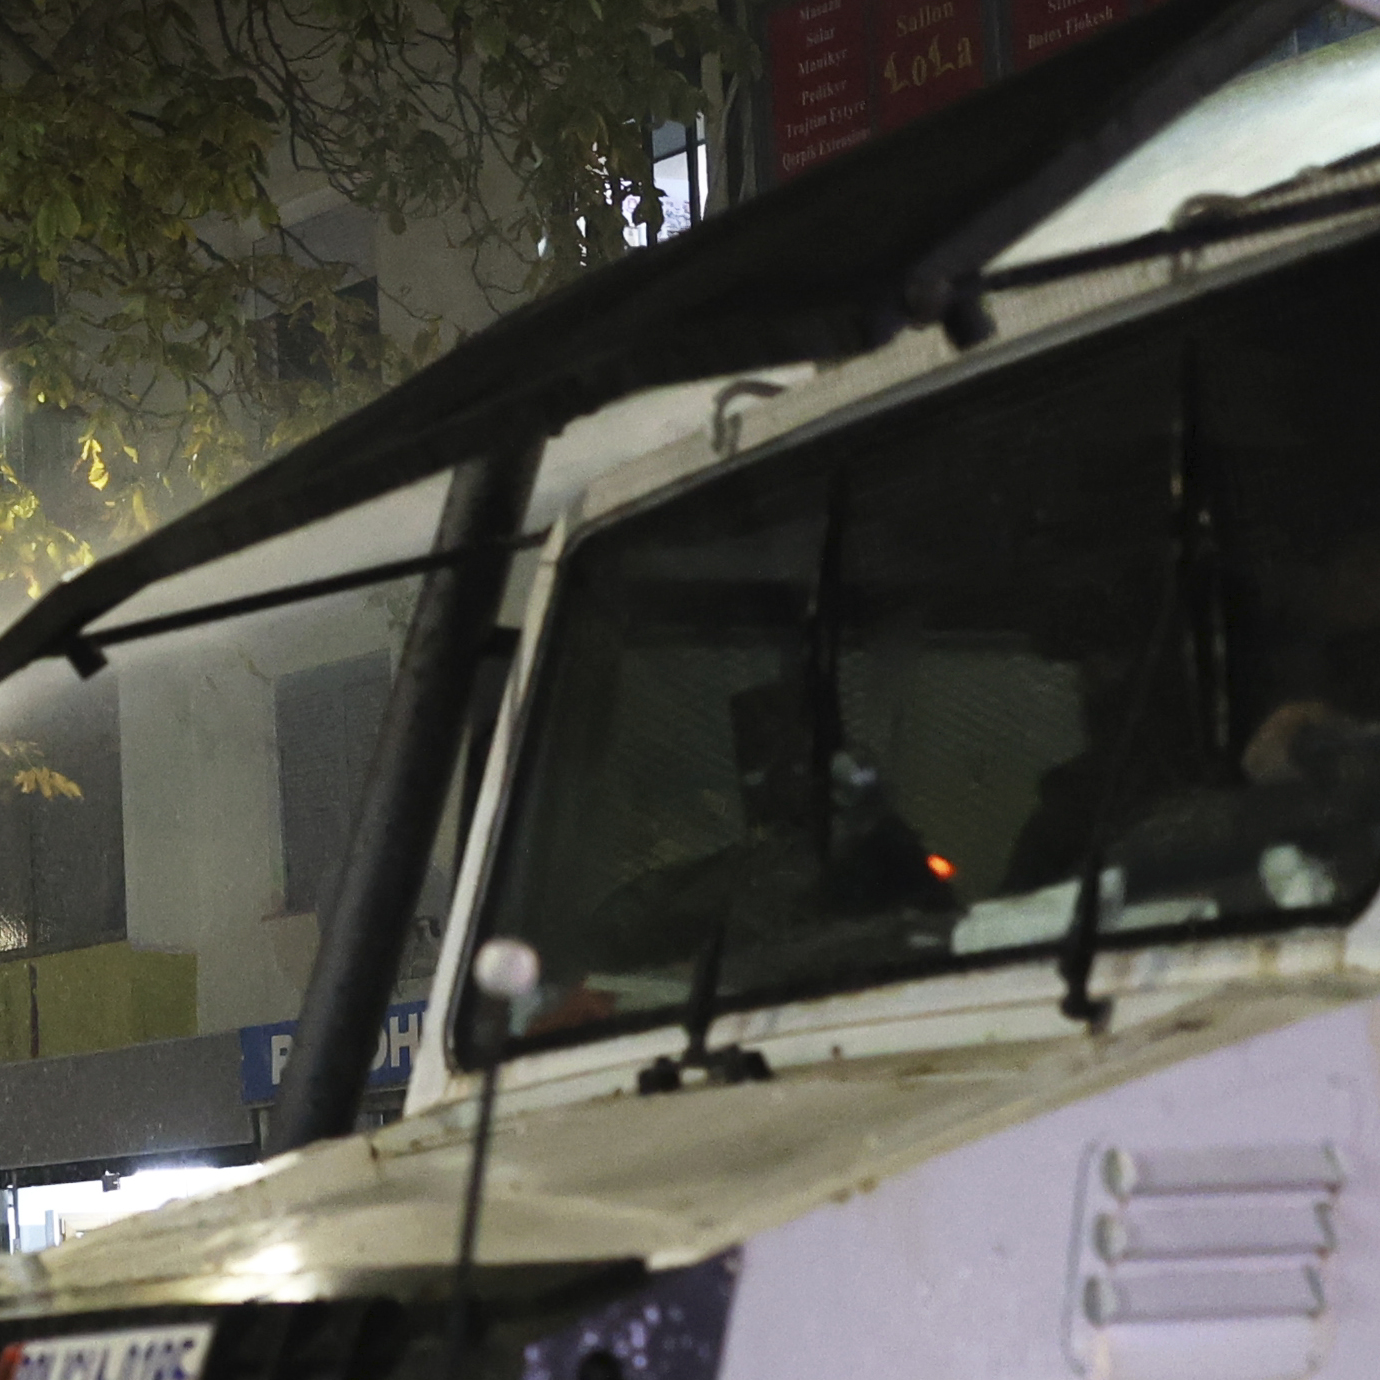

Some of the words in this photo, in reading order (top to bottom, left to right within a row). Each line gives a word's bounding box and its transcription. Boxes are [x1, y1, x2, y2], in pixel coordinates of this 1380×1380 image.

[896, 2, 954, 37] Sallon
[798, 49, 848, 75] Manikyr
[801, 80, 847, 105] Pedikyr
